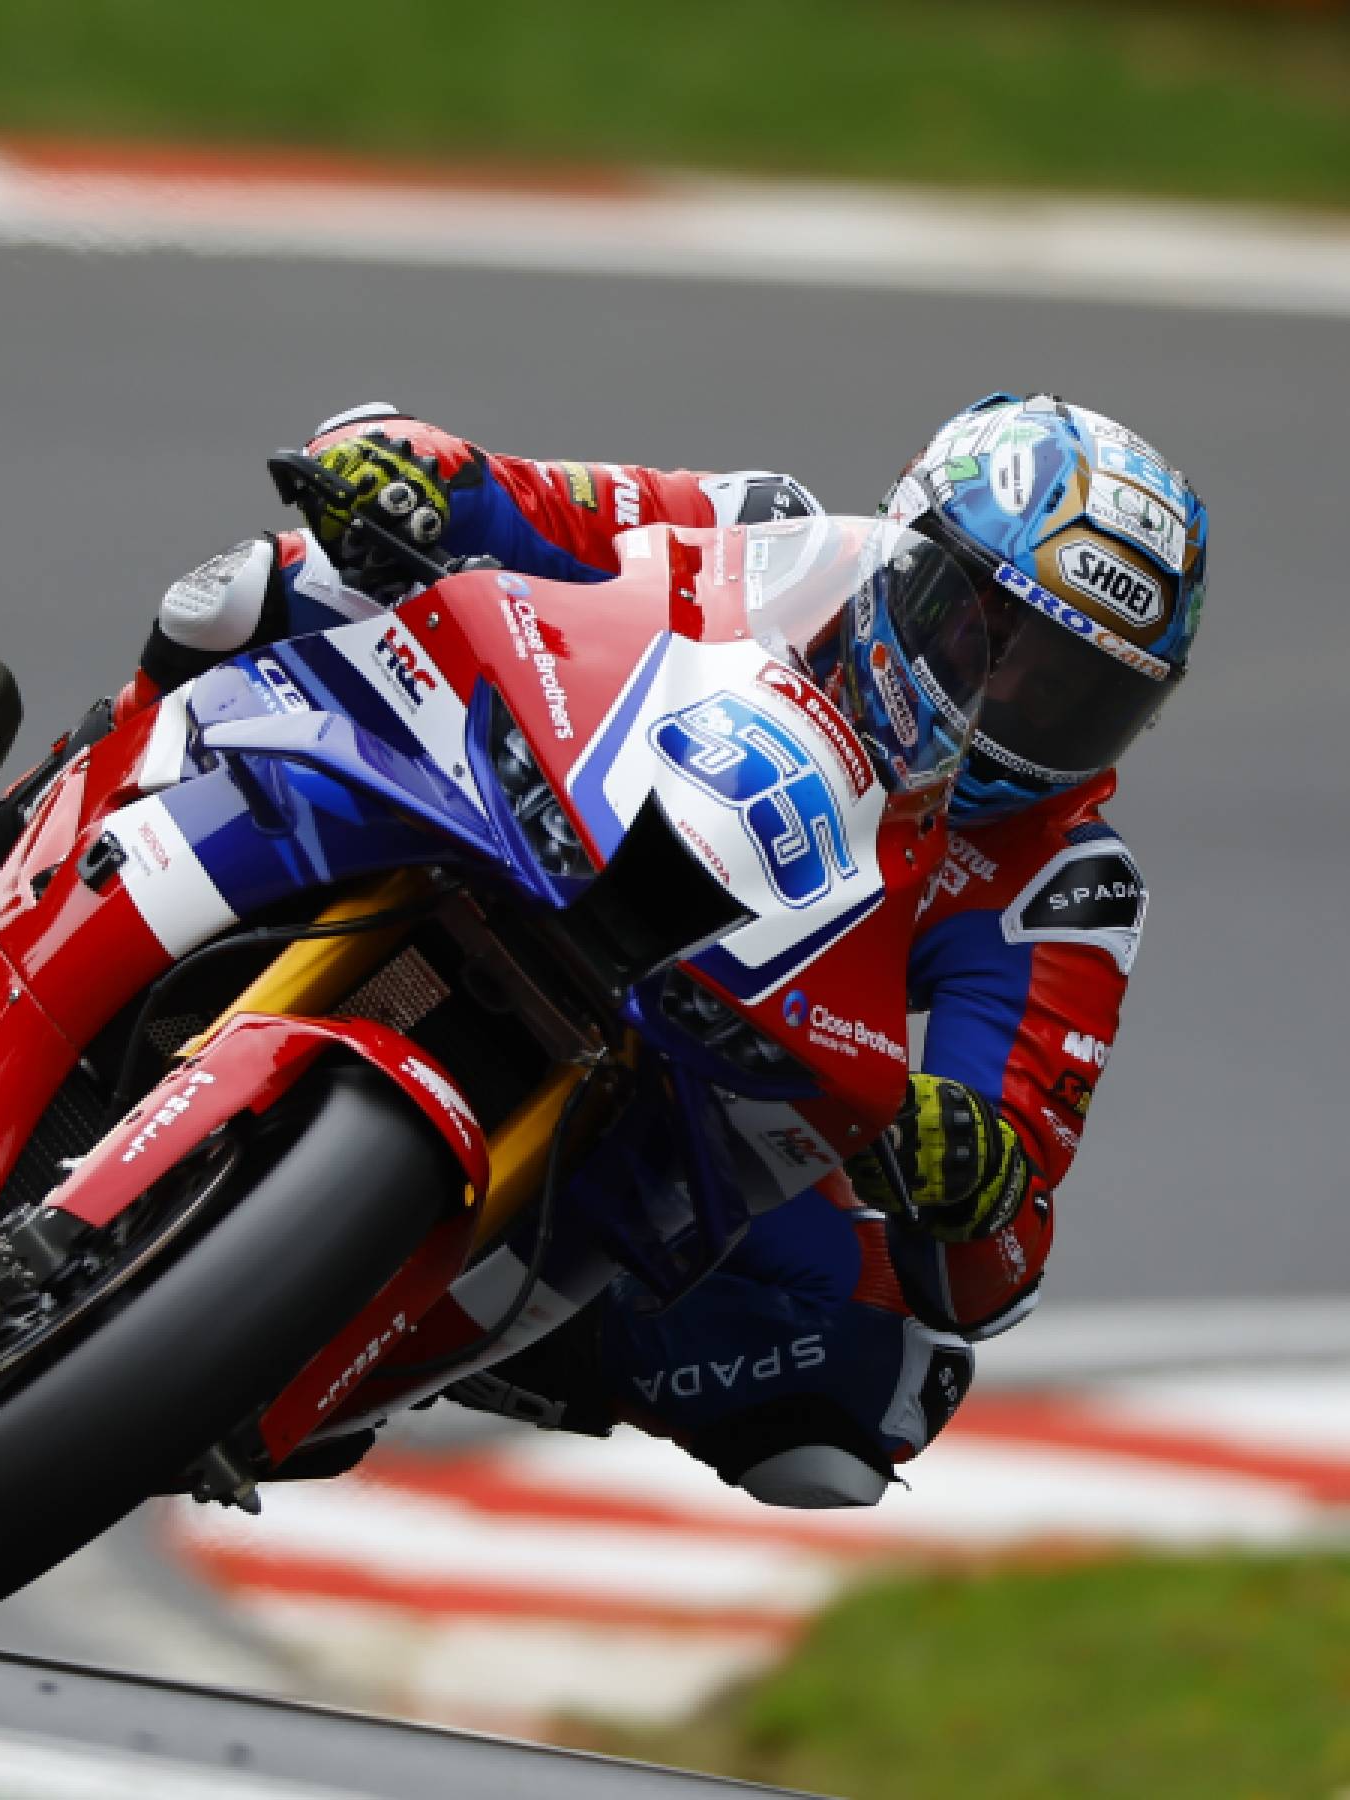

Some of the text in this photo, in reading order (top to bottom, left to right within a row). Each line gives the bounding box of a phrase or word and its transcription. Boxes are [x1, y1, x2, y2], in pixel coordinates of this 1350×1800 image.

[1000, 565, 1094, 634] PRO
[1072, 551, 1153, 618] SHOEI
[374, 626, 438, 707] HRC
[516, 600, 575, 740] Close Brothers
[806, 698, 869, 791] Bennetts
[647, 690, 860, 910] 55
[677, 819, 730, 885] HONDA
[1049, 878, 1142, 911] SPADA
[811, 1004, 854, 1038] Close
[631, 1333, 827, 1403] SPADA
